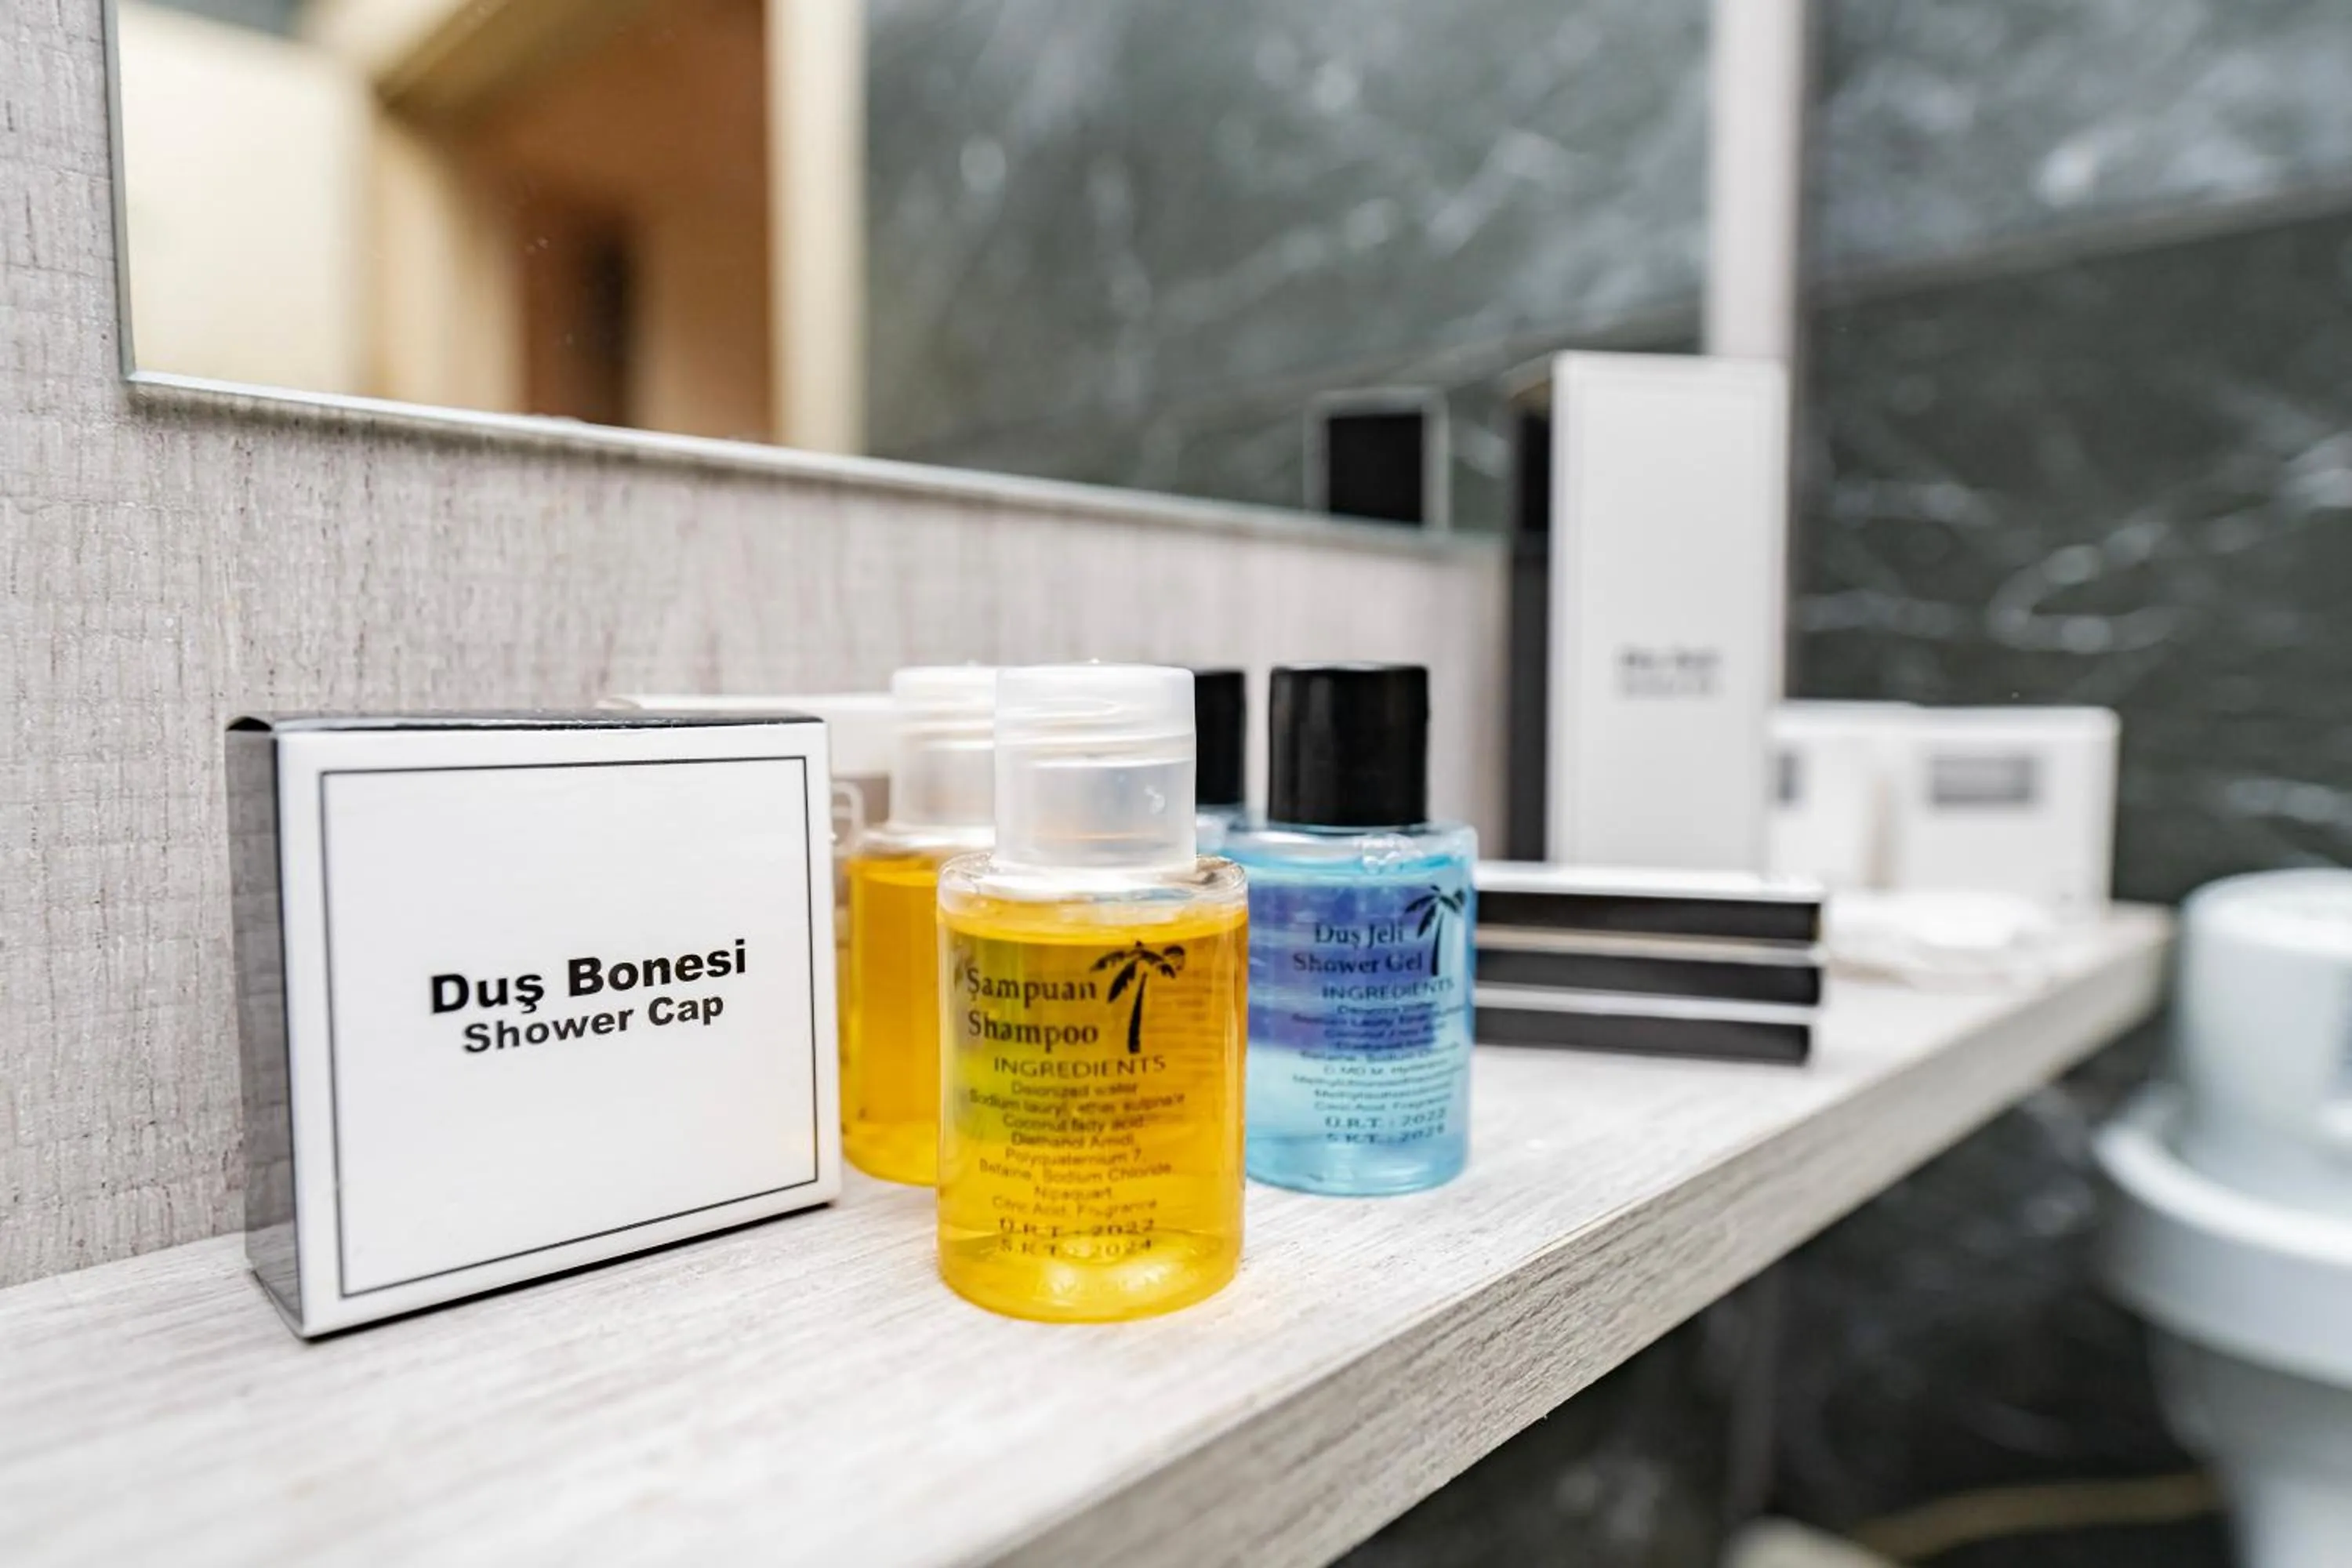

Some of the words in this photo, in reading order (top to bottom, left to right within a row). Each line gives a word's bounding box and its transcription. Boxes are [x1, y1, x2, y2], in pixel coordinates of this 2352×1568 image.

[1315, 922, 1361, 949] Duş
[1367, 920, 1404, 947] Jeli
[430, 972, 544, 1014] Duş
[568, 938, 746, 997] Bonesi
[1293, 952, 1380, 974] Shower
[1385, 951, 1424, 973] Gel
[967, 967, 1097, 1007] Şampuan
[1322, 978, 1455, 1000] INGREDIENTS
[463, 1006, 634, 1053] Shower
[648, 995, 724, 1025] Cap
[967, 1010, 1098, 1052] Shampoo
[993, 1054, 1167, 1078] INGREDIENTS
